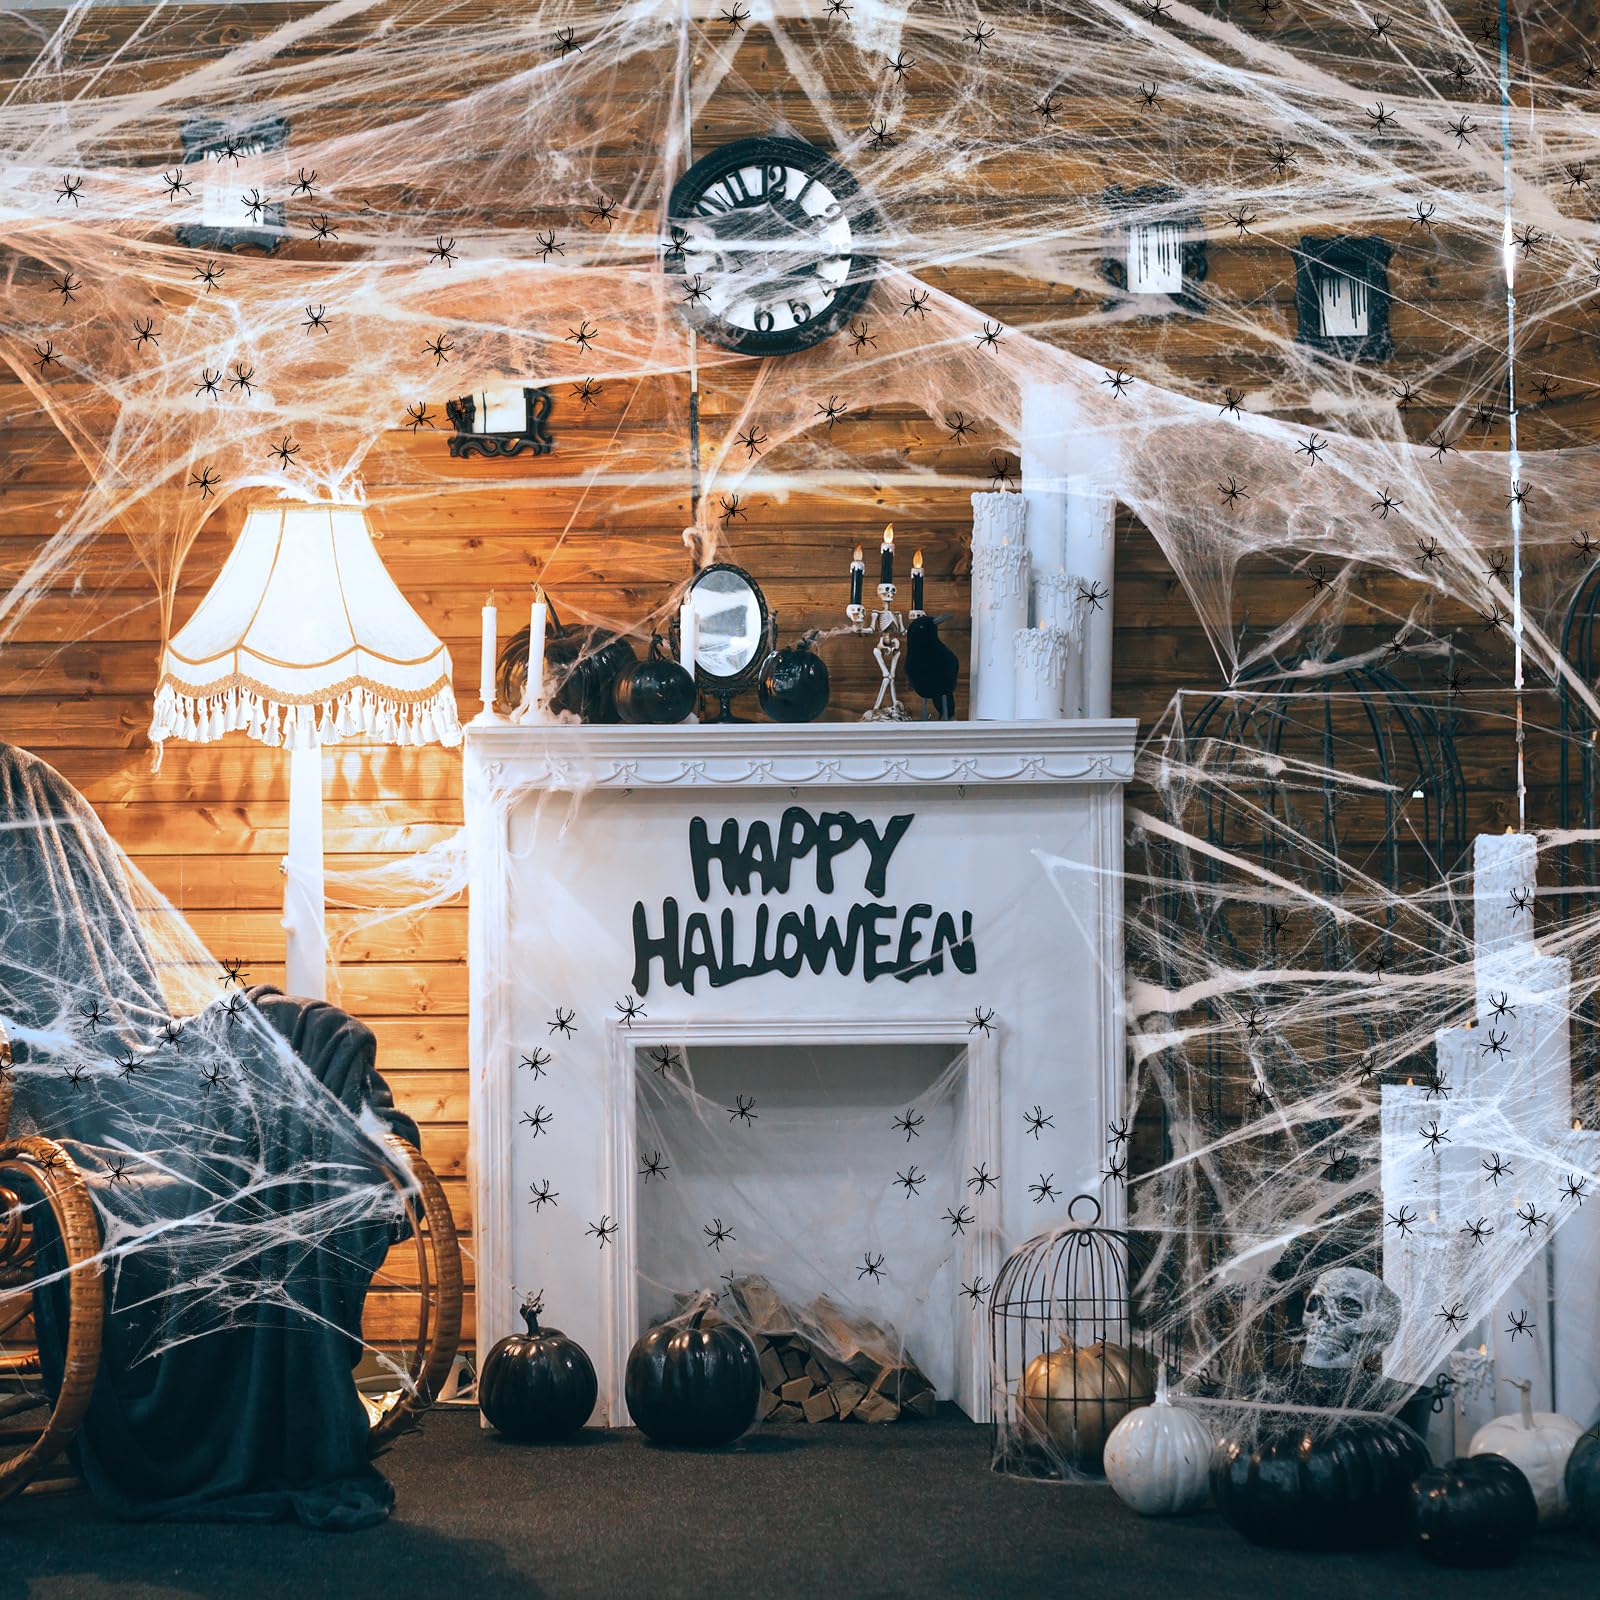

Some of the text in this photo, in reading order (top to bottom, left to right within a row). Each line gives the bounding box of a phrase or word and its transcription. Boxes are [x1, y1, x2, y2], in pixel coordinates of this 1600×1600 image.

[755, 164, 787, 201] 12
[753, 303, 775, 332] 6
[787, 299, 811, 324] 5
[689, 806, 915, 902] HAPPY
[632, 897, 976, 997] HALLOWEEN
